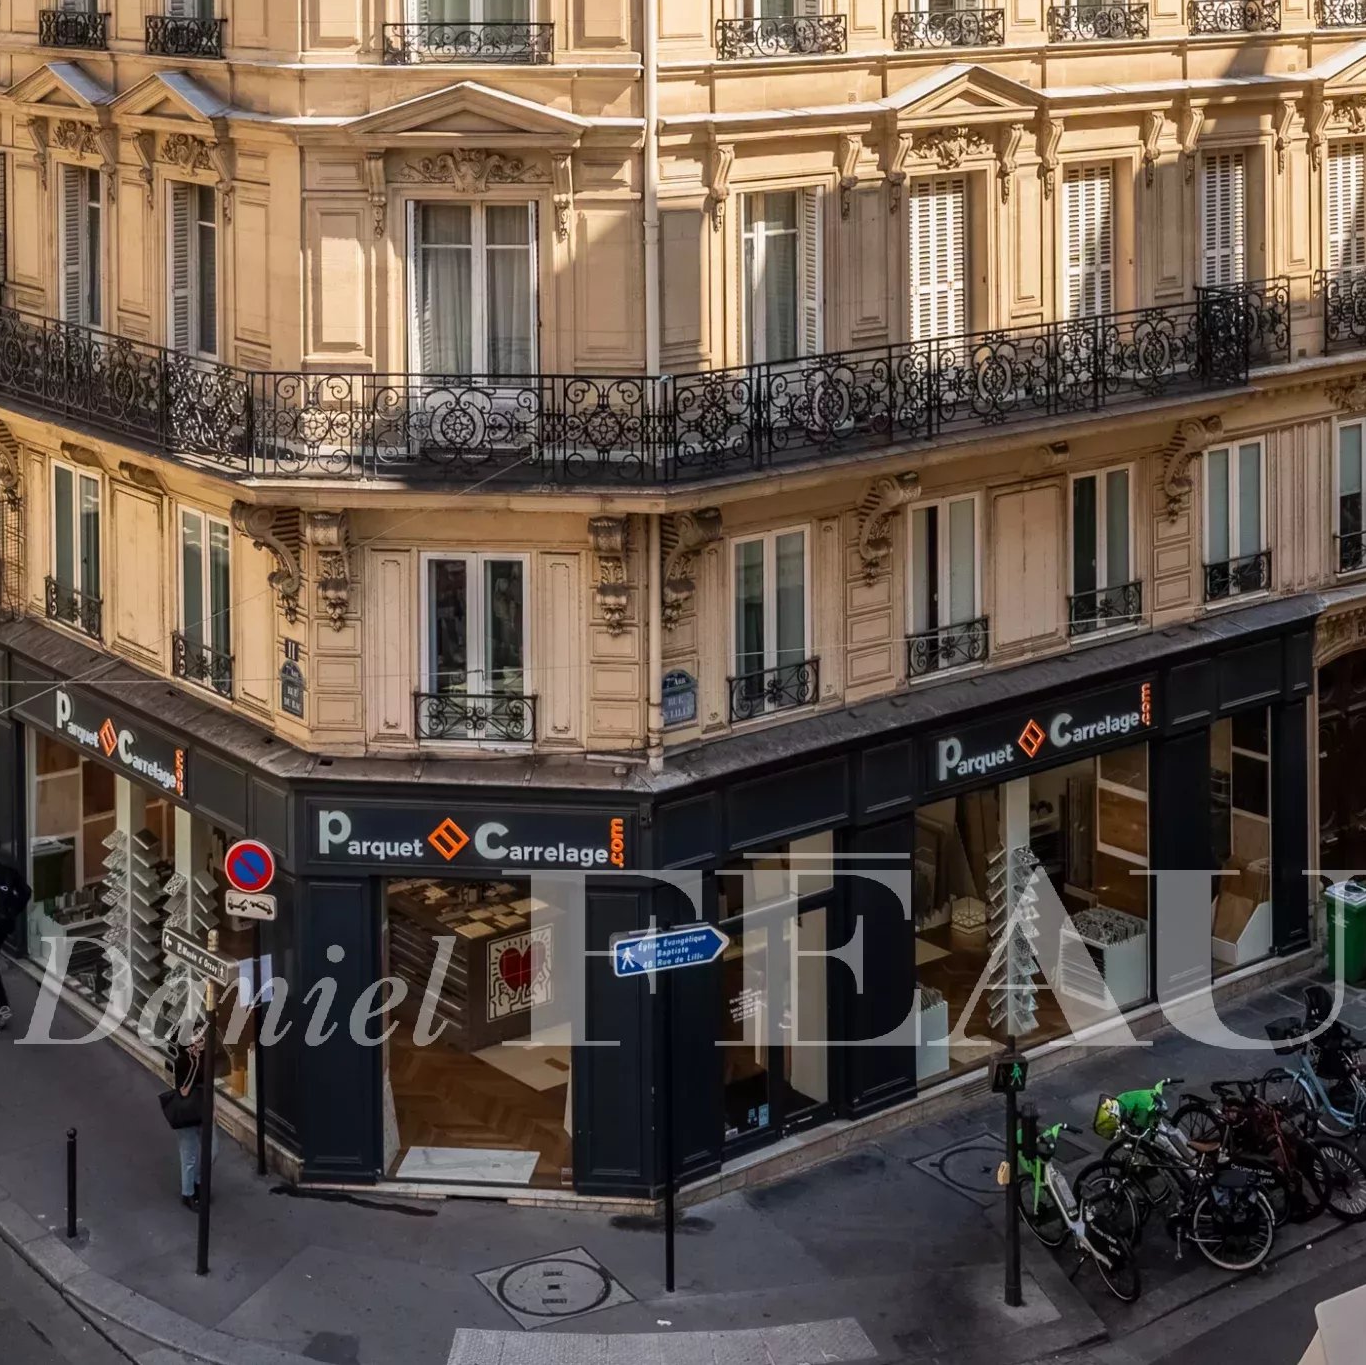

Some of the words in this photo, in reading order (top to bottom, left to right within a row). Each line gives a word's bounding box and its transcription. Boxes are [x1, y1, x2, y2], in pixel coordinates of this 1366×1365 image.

[56, 690, 99, 748] Parquet
[118, 729, 177, 789] Carrelage
[938, 736, 1014, 781] Parquet
[1050, 712, 1140, 748] Carrelage
[319, 809, 424, 860] Parquet
[474, 821, 609, 867] Carrelage
[610, 818, 624, 868] .com
[656, 947, 689, 958] Baptiste
[657, 958, 672, 967] Rue
[674, 955, 684, 963] de
